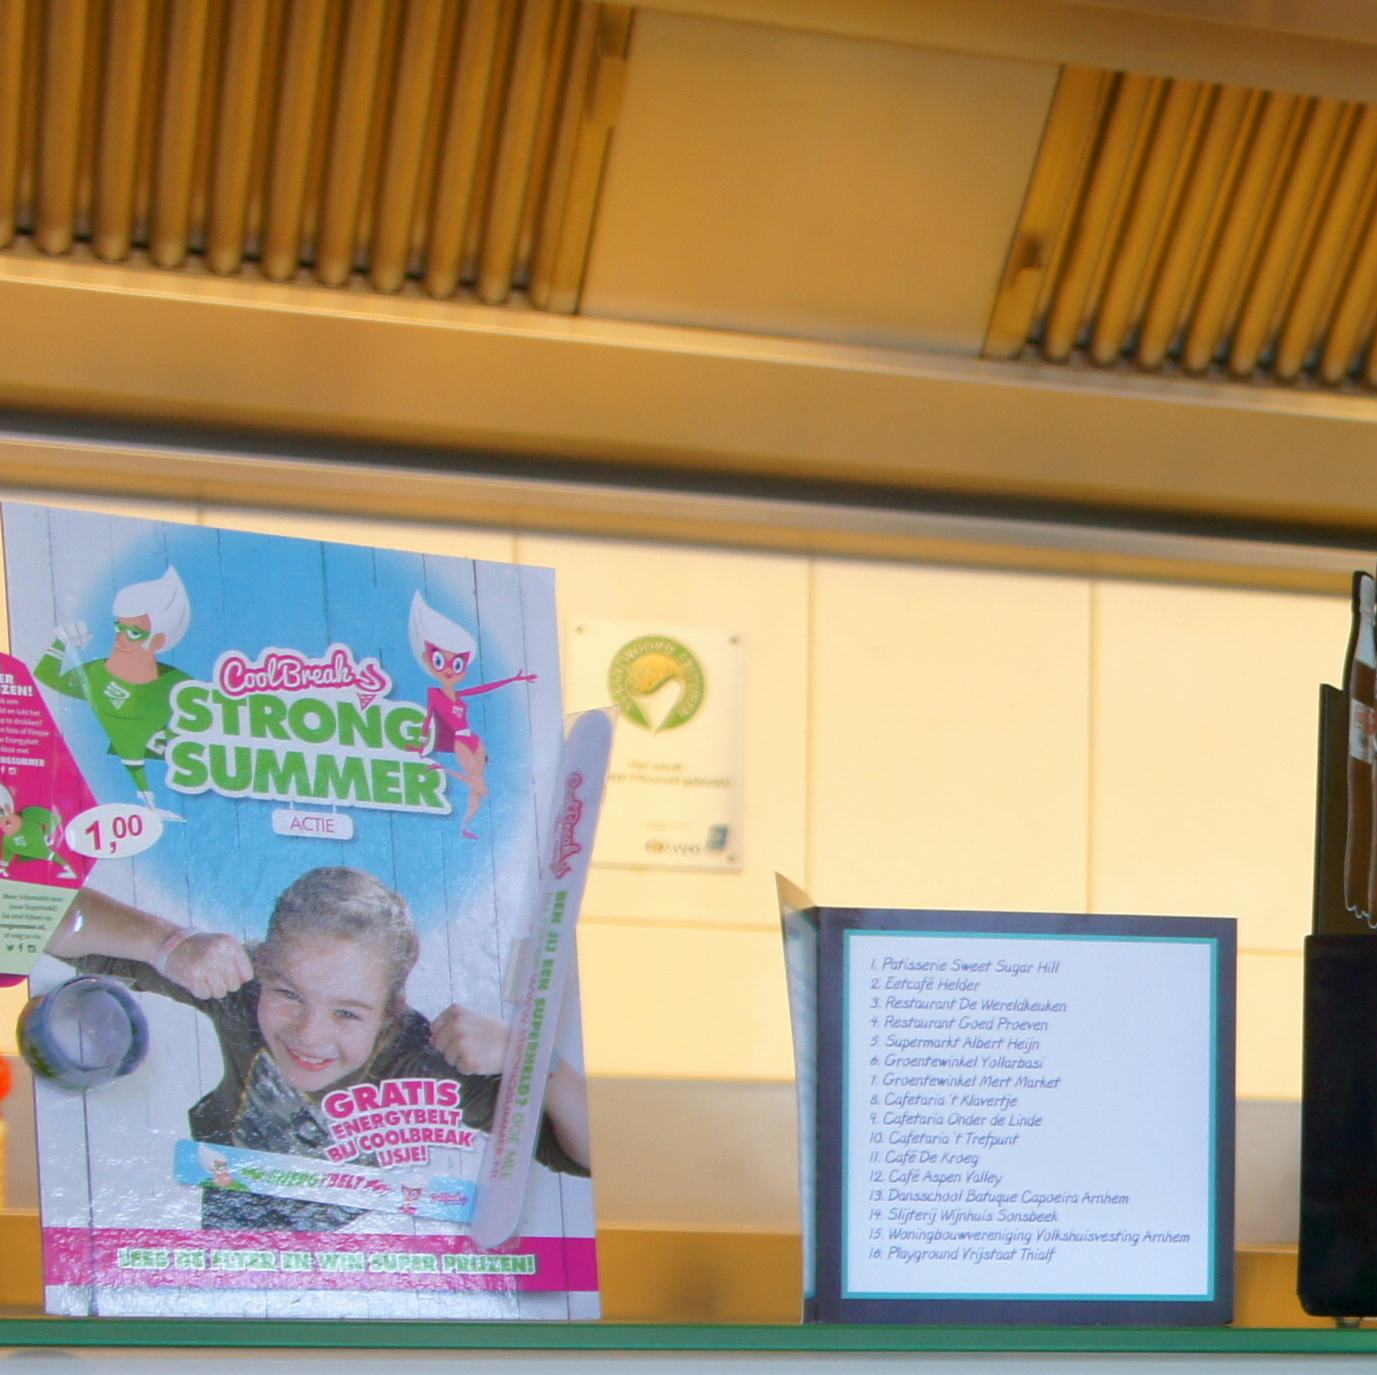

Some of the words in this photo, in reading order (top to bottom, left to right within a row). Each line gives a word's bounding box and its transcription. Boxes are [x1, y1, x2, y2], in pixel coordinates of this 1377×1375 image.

[219, 649, 353, 697] CoolBreak
[175, 686, 424, 752] STRONG
[171, 741, 445, 809] SUMMER
[84, 815, 144, 855] 1,00
[290, 816, 335, 833] ACTIE
[881, 956, 947, 973] Patisserie
[950, 958, 993, 973] Sweet
[994, 959, 1035, 978] Sugar
[1036, 959, 1060, 974] Hill
[884, 975, 935, 994] Eetcafé
[936, 977, 981, 992] Helder
[884, 995, 958, 1011] Restaurant
[980, 997, 1067, 1013] Wereldkeuken
[883, 1014, 957, 1030] Restaurant
[958, 1015, 996, 1031] Goed
[996, 1016, 1049, 1032] Proeven
[884, 1033, 960, 1052] Supermarkt
[962, 1035, 1005, 1050] Albert
[1006, 1036, 1040, 1055] Heijn
[883, 1052, 979, 1069] Groentewinkel
[882, 1071, 978, 1088] Groentewinkel
[978, 1074, 1013, 1088] Mert
[1013, 1075, 1062, 1089] Market
[325, 1081, 459, 1119] GRATIS
[332, 1109, 460, 1140] ENERGYBELT
[947, 1112, 988, 1127] Onder
[1008, 1112, 1043, 1128] Linde
[359, 1128, 473, 1148] COOLBREAK
[965, 1130, 1020, 1150] Trefpunt
[884, 1148, 918, 1166] Café
[939, 1151, 980, 1169] Kroeg
[888, 1168, 921, 1186] Café
[922, 1169, 962, 1188] Aspen
[965, 1169, 1003, 1188] Valley
[887, 1187, 963, 1203] Dansschool
[1020, 1189, 1079, 1208] Capoeira
[1080, 1191, 1130, 1205] Arnhem
[887, 1206, 938, 1226] Slijterij
[940, 1207, 993, 1227] Wijnhuis
[996, 1208, 1058, 1223] Sonsbeek
[1036, 1228, 1139, 1247] Volkshuisvesting
[1141, 1230, 1192, 1244] Arnhem
[887, 1245, 960, 1265] Playground
[962, 1246, 1018, 1266] Vrijstaat
[1019, 1246, 1057, 1265] Thialf
